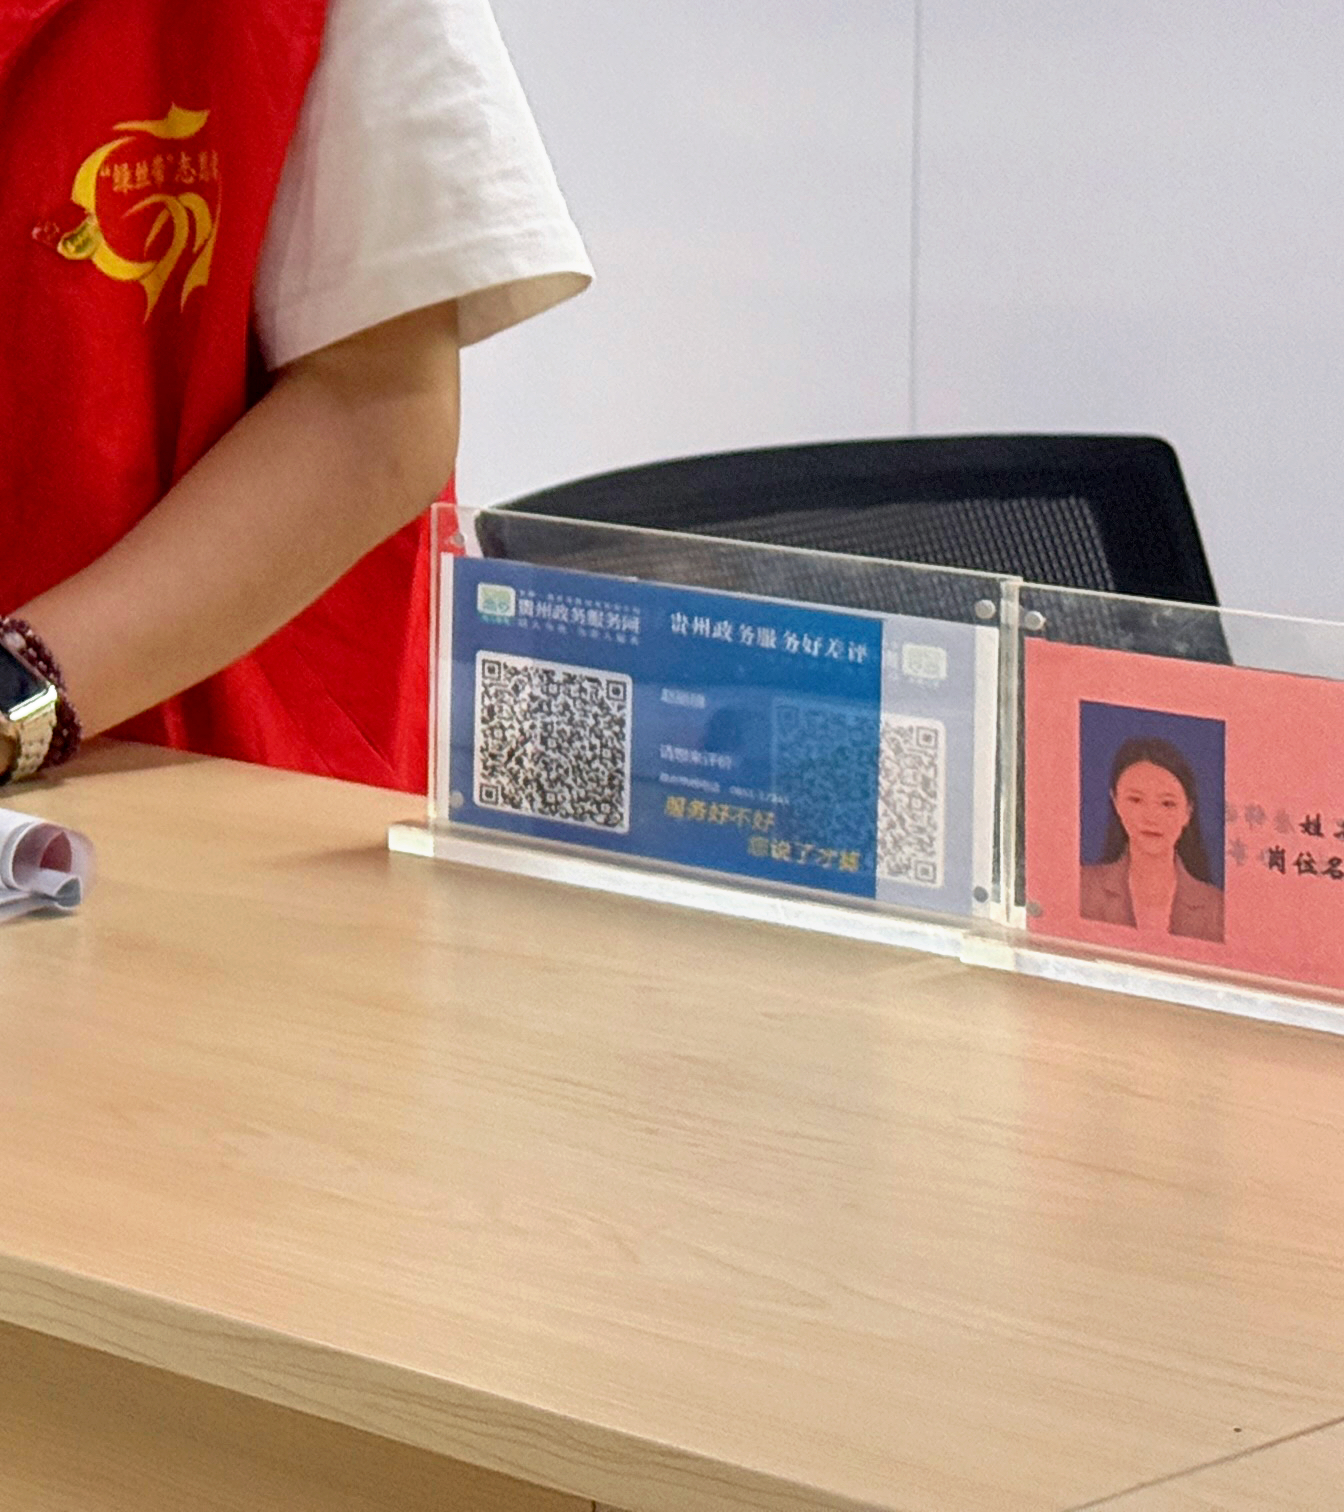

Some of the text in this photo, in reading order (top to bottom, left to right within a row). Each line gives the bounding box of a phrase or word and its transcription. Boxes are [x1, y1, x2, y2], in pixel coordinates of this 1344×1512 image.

[670, 611, 869, 664] 贵州政务服务好差评
[665, 795, 776, 833] 服务好不好
